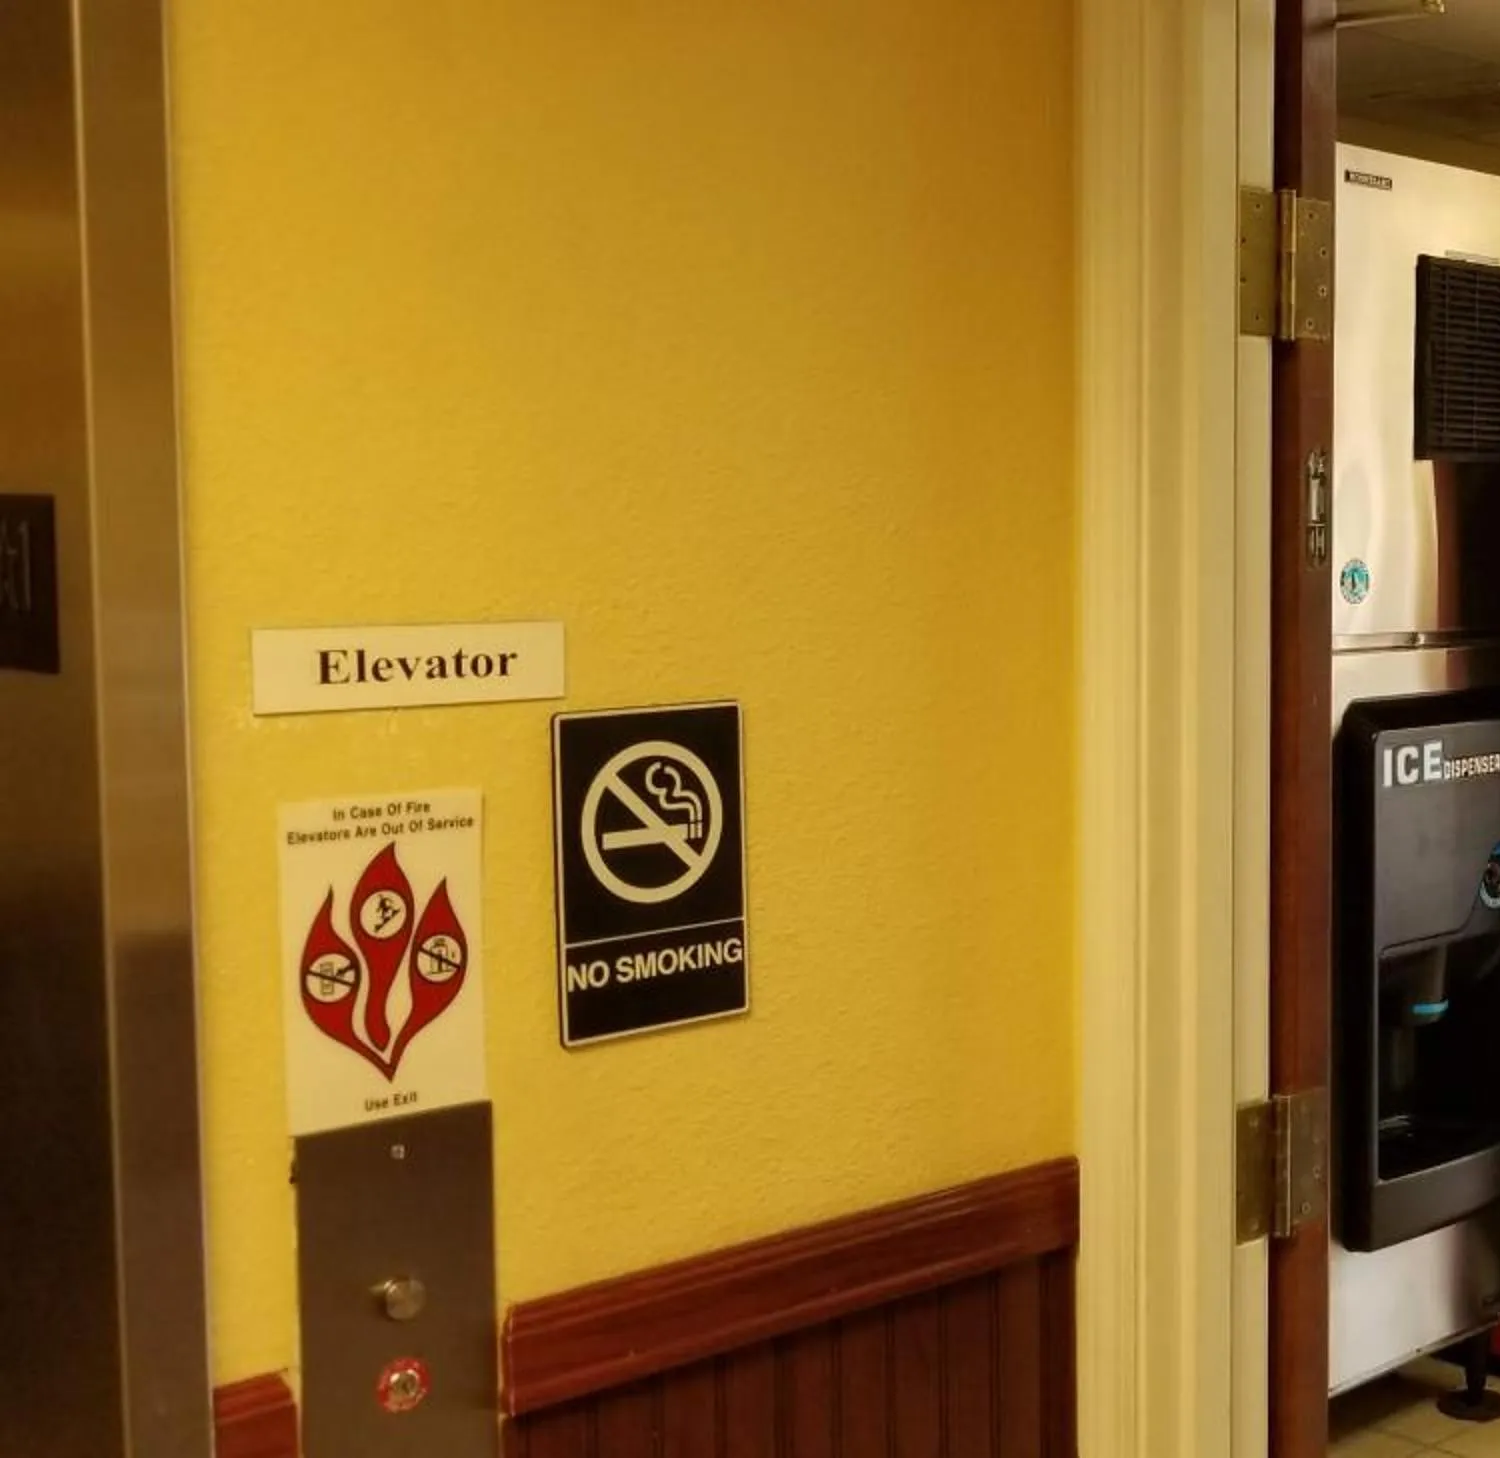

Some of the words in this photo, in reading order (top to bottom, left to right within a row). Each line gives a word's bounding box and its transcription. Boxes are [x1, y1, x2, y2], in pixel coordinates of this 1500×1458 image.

[318, 648, 518, 685] Elevator
[1383, 740, 1442, 788] ICE
[1443, 753, 1500, 780] DISPENSER
[332, 808, 345, 821] In
[350, 805, 382, 819] Case
[387, 802, 400, 816] Of
[405, 801, 431, 814] Fire
[287, 828, 350, 845] Elevators
[355, 825, 377, 838] Are
[381, 821, 404, 836] Out
[409, 819, 423, 832] Of
[427, 816, 474, 831] Service
[567, 960, 611, 993] NO
[615, 937, 743, 984] SMOKING
[364, 1098, 389, 1112] Use
[393, 1091, 418, 1106] Exit
